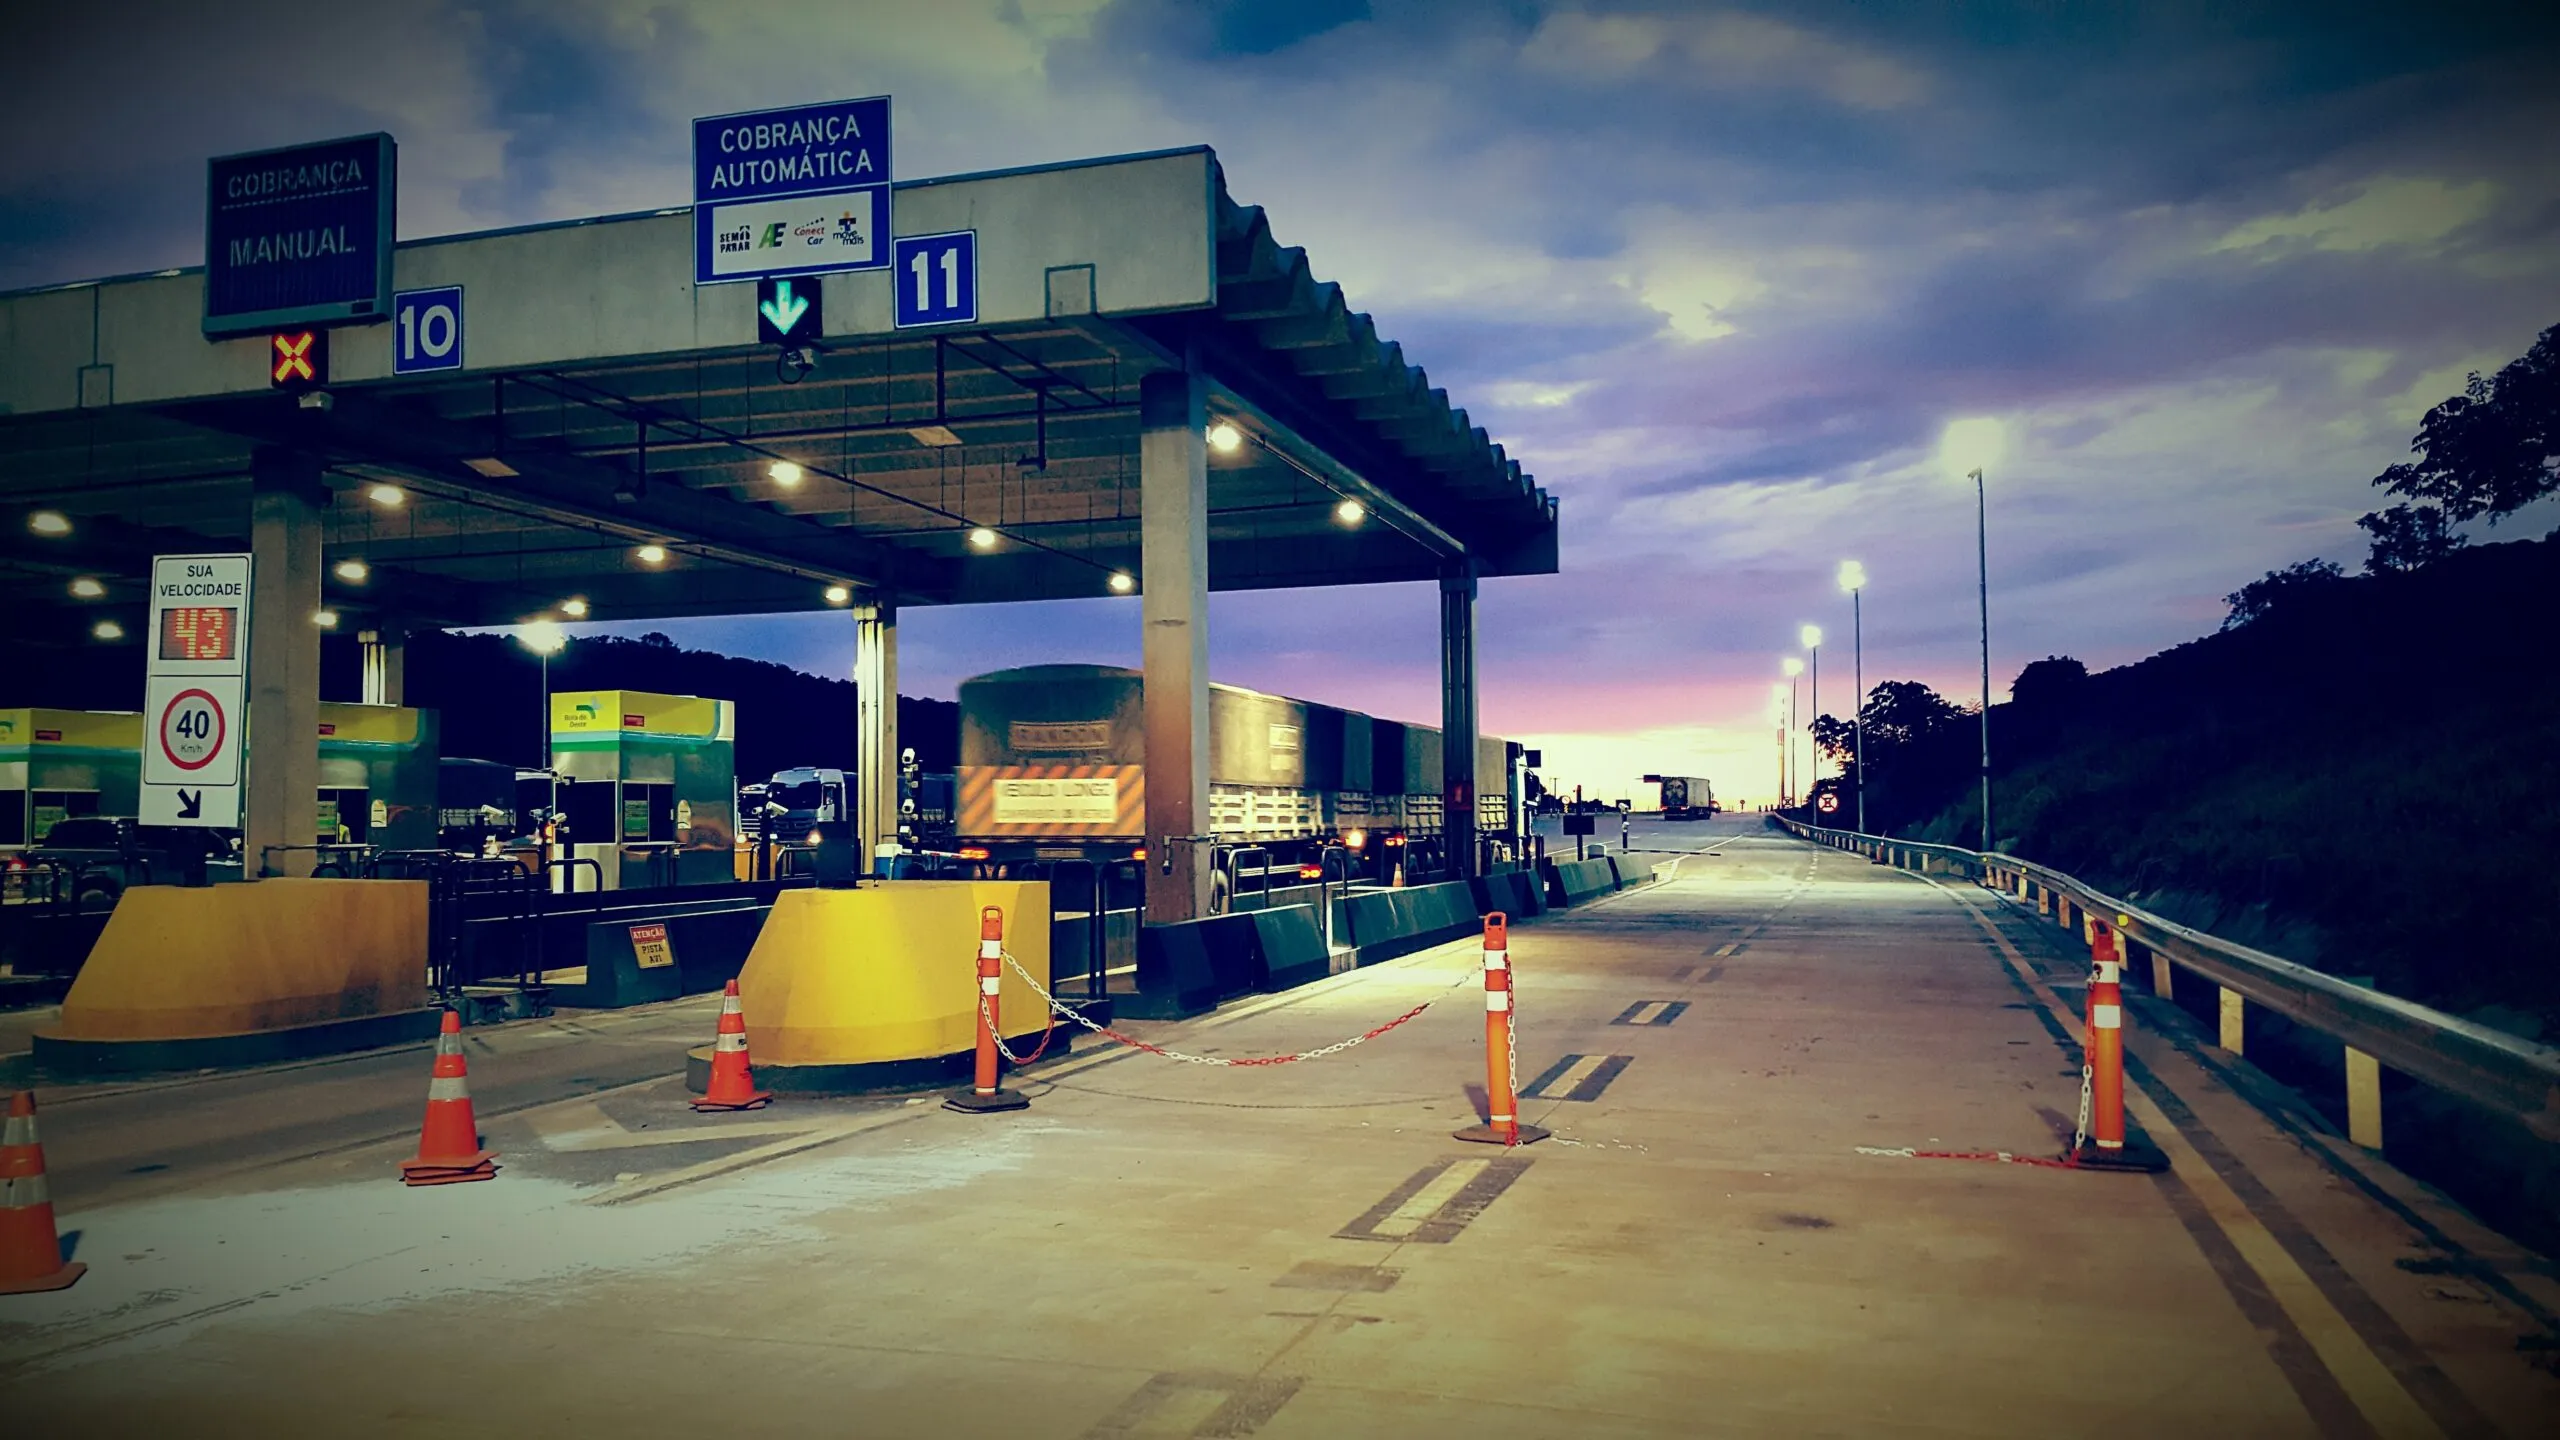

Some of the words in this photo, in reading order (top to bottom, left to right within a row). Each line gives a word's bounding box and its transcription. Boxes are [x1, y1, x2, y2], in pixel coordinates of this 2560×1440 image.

[720, 114, 861, 153] COBRANÇA
[710, 145, 873, 189] AUTOMÁTICA
[228, 159, 362, 198] COBRANÇA
[794, 227, 825, 237] Conect
[807, 236, 824, 246] Car
[832, 229, 858, 240] move
[842, 235, 865, 246] mais
[230, 225, 356, 268] MANUAL
[720, 241, 750, 253] PARAR
[911, 248, 958, 312] 11
[400, 304, 456, 360] 10
[187, 565, 214, 578] SUA
[160, 583, 242, 597] VELOCIDADE
[175, 609, 224, 659] 43
[176, 710, 210, 740] 40
[642, 944, 663, 953] PISTA
